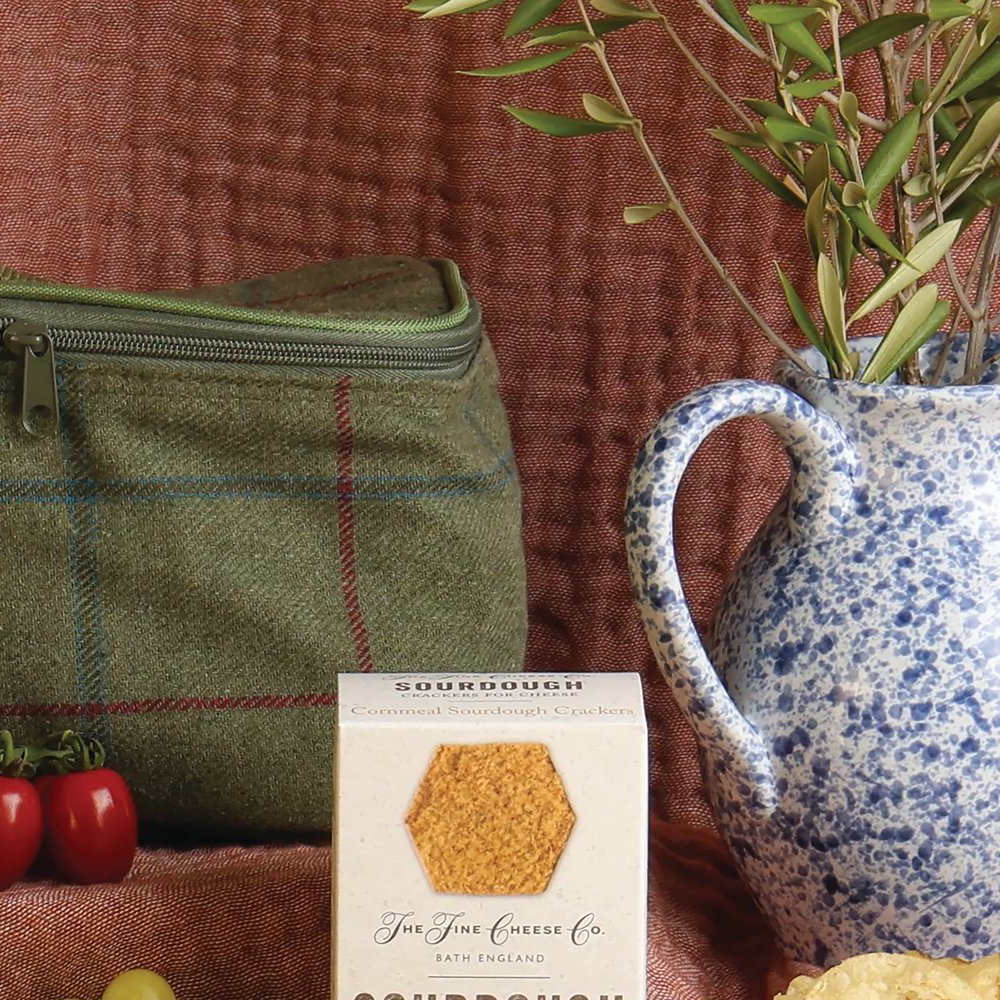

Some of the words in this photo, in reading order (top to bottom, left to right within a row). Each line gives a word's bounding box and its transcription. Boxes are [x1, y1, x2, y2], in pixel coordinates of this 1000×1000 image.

[395, 681, 583, 691] SOURDOUGH
[351, 705, 441, 716] Cornmeal
[448, 705, 547, 717] Sourdough
[554, 705, 636, 716] Crackers
[436, 954, 471, 963] BATH
[478, 954, 545, 963] ENGLAND
